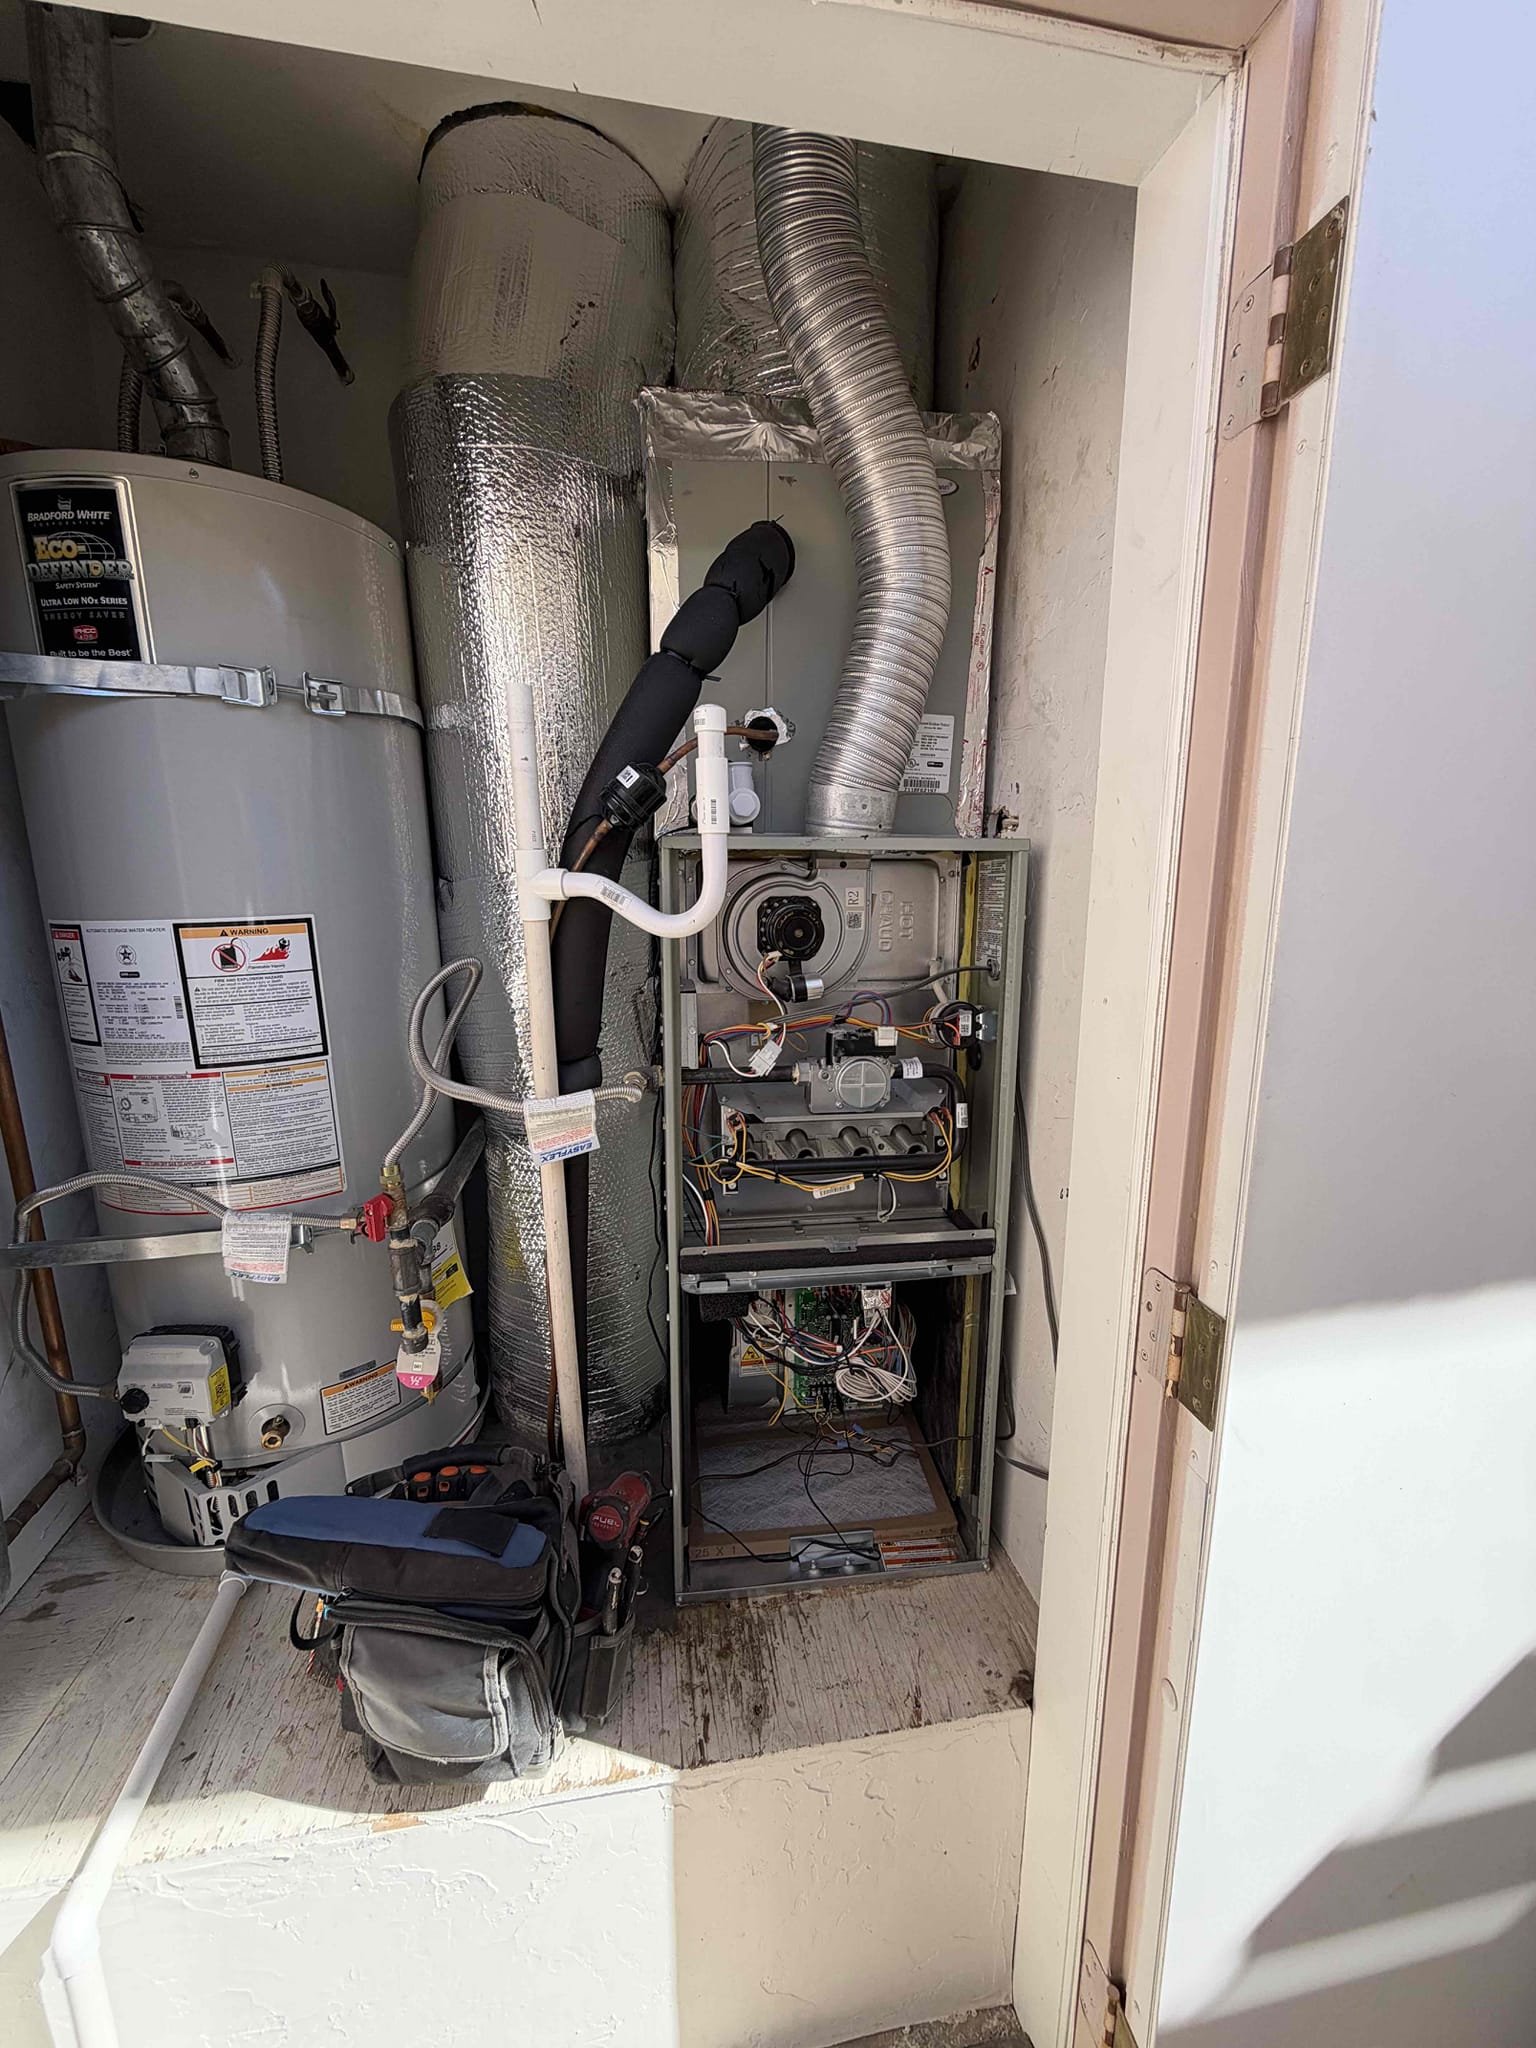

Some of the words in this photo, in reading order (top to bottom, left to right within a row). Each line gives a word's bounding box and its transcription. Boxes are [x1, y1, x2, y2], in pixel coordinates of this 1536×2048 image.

[27, 511, 75, 522] BRADFORD
[76, 509, 110, 520] WHITE
[26, 559, 134, 580] DEFENDER
[55, 582, 75, 590] SAFETY
[41, 598, 62, 607] ULTRA
[63, 597, 79, 605] LOW
[100, 596, 128, 605] SERIES
[68, 649, 77, 657] to
[78, 648, 90, 657] be
[91, 648, 106, 657] the
[107, 647, 131, 657] Best
[847, 890, 860, 906] R2
[879, 888, 895, 953] CHAUD
[899, 900, 915, 941] HOT
[229, 927, 269, 936] WARNING
[540, 1141, 593, 1163] EASYFLEX
[348, 1371, 379, 1388] WARNING
